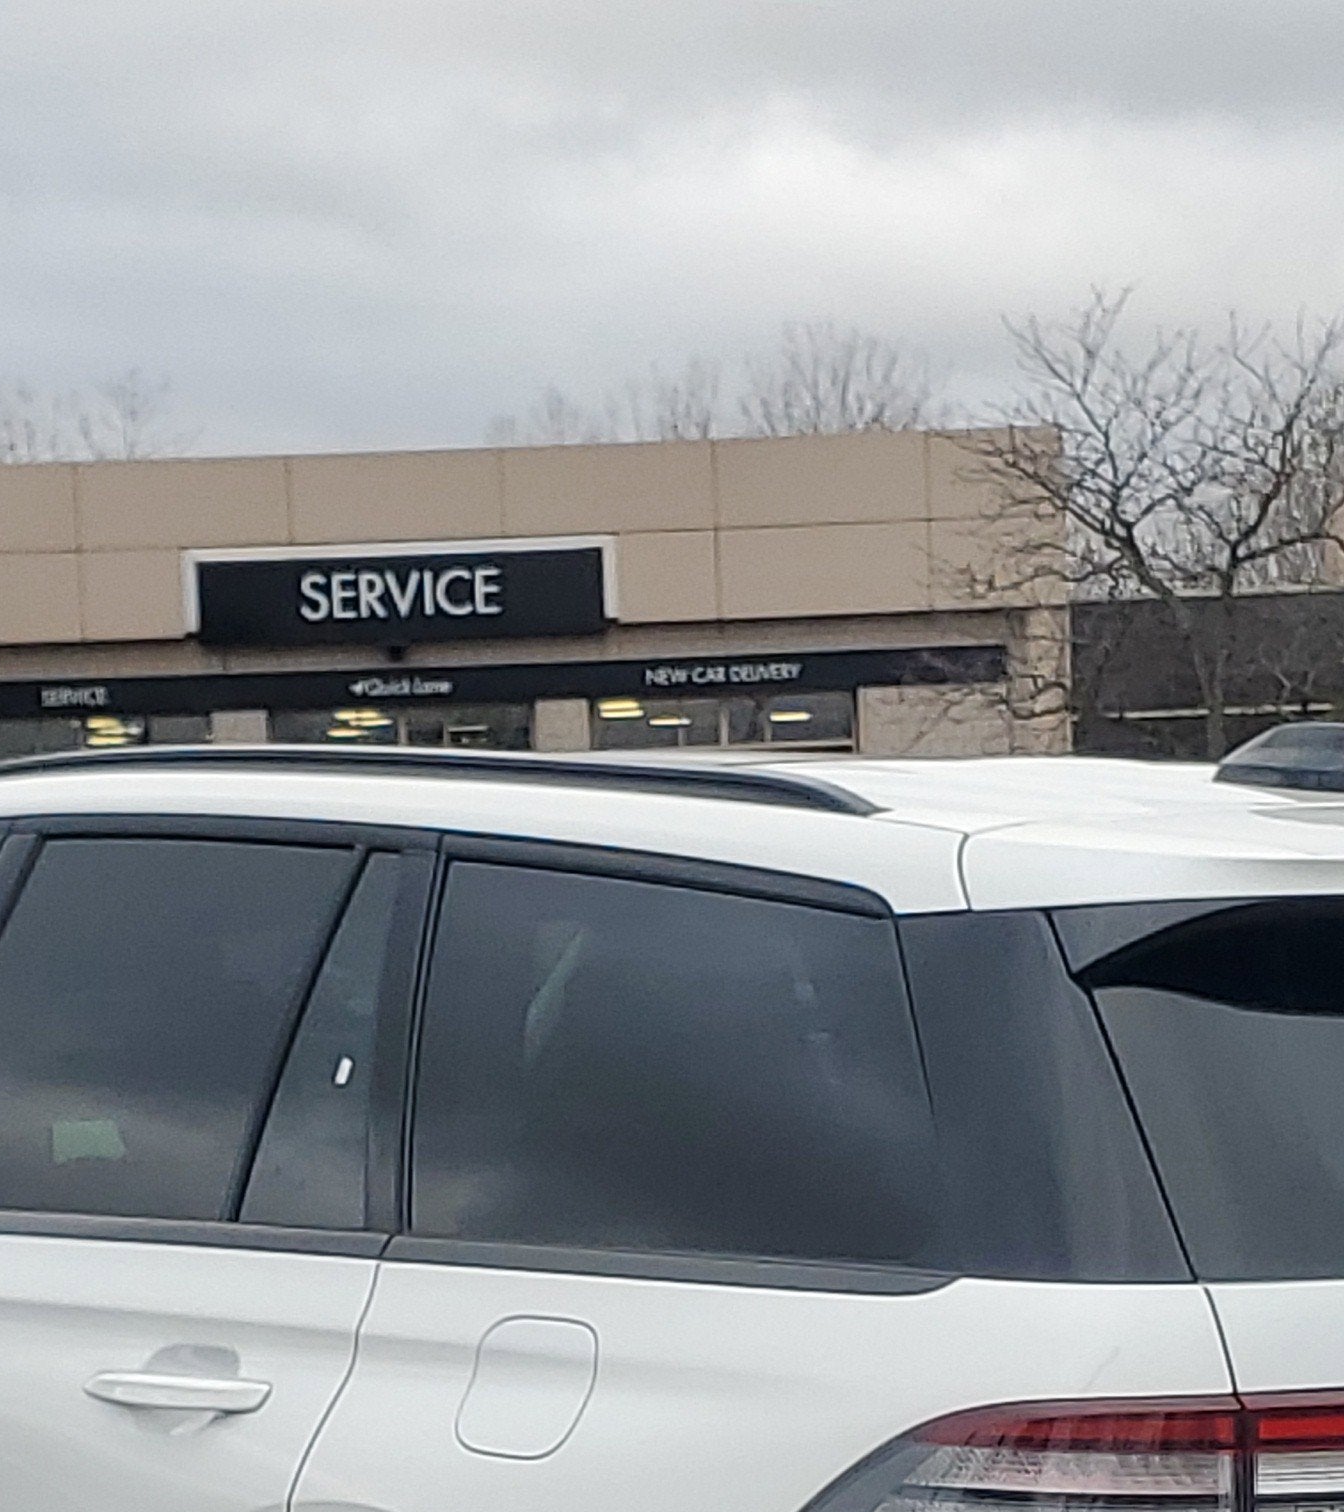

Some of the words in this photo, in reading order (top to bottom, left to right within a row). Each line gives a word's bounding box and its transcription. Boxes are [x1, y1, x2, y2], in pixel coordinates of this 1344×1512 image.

[300, 567, 502, 622] SERVICE
[644, 665, 688, 686] NEW
[691, 666, 726, 683] CAR
[729, 663, 801, 682] DELIVERY
